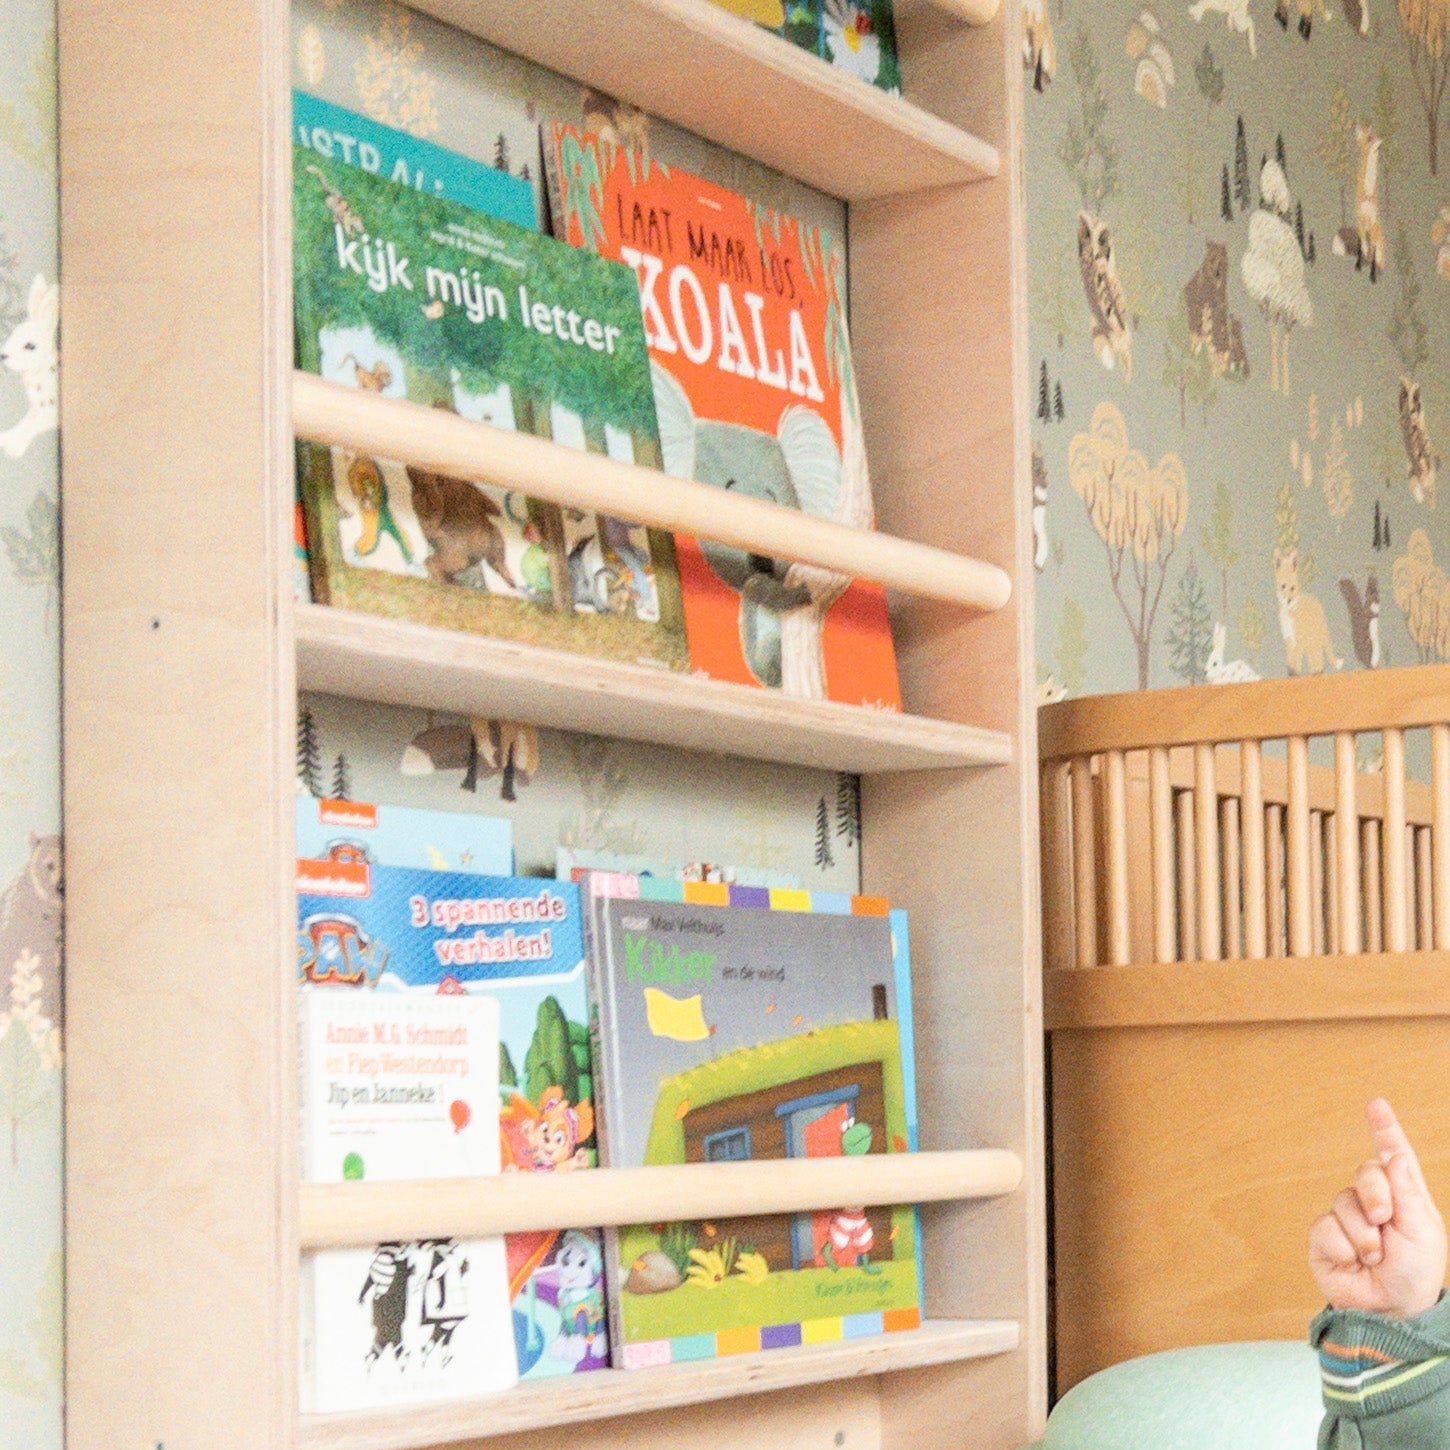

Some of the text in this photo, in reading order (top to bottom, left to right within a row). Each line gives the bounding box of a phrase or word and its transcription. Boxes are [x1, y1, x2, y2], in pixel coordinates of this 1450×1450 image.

[617, 193, 672, 253] LAAT
[687, 219, 751, 284] MAAR
[335, 222, 414, 293] kijk
[426, 265, 508, 325] mijn
[518, 285, 621, 355] letter
[620, 245, 825, 403] KOALA
[411, 889, 567, 932] 3 spannende
[434, 928, 553, 965] verhalen!
[623, 932, 719, 986] Kikker
[326, 1022, 369, 1045] Annie
[406, 1024, 469, 1046] Schmidt
[352, 1085, 370, 1104] en
[372, 1082, 437, 1105] Janneke
